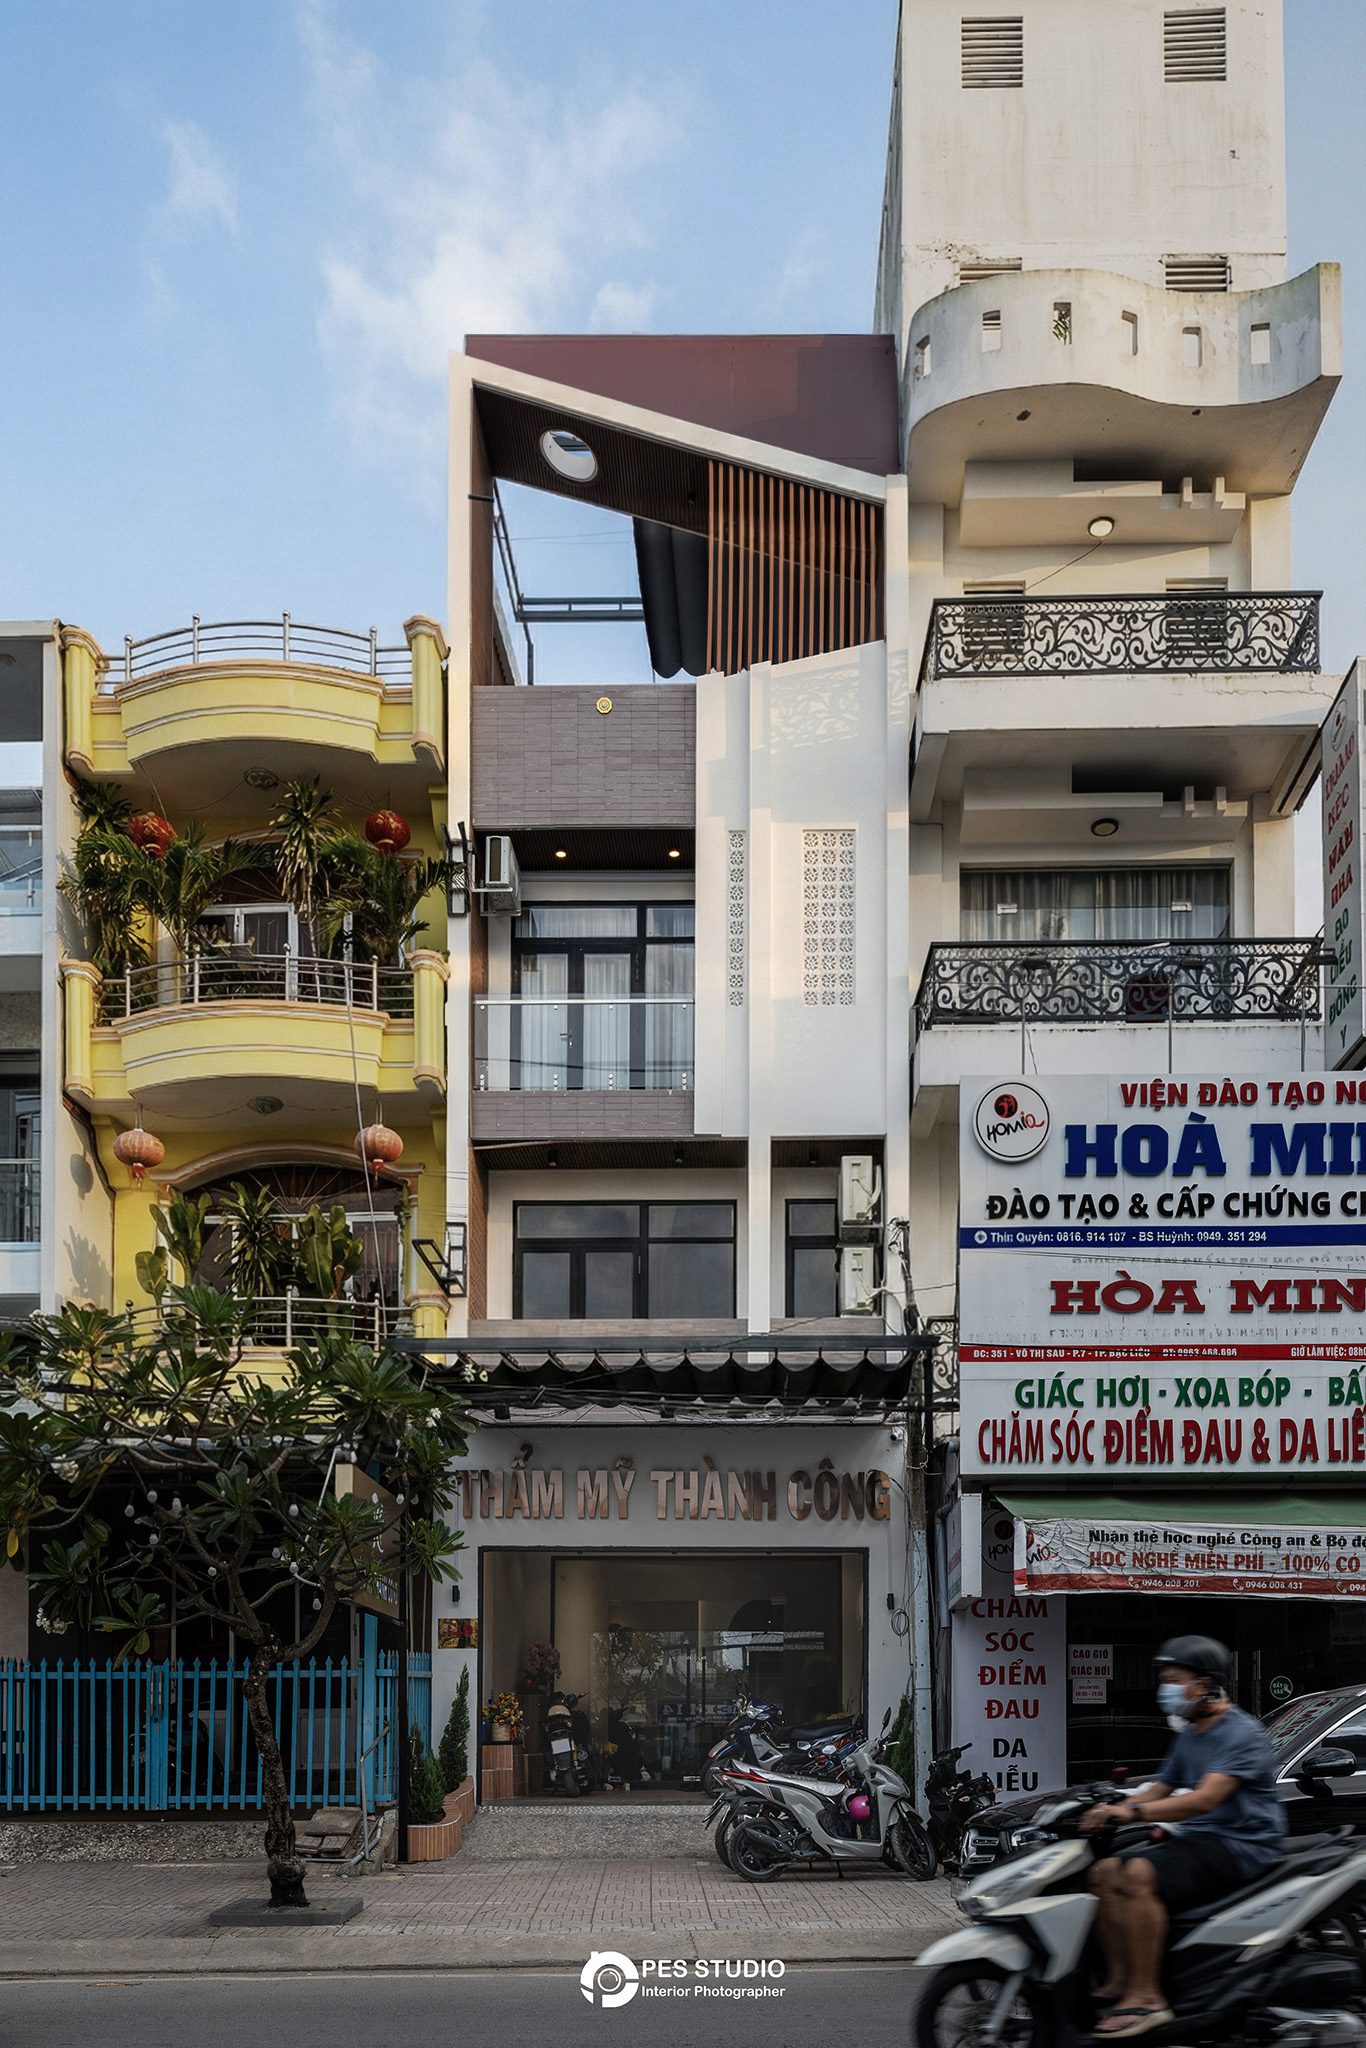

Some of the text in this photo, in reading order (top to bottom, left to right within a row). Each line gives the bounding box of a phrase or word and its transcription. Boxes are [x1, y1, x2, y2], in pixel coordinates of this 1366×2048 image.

[1120, 1081, 1188, 1111] VIỆN
[1199, 1078, 1258, 1106] ĐÀO
[1267, 1081, 1325, 1109] TẠO
[1065, 1111, 1366, 1177] HOÀ MI
[986, 1187, 1050, 1219] ĐÀO
[1058, 1193, 1119, 1224] TẠO
[1129, 1193, 1149, 1218] &
[1157, 1184, 1215, 1218] CẤP
[1223, 1184, 1330, 1217] CHỨNG
[1087, 1231, 1105, 1242] 914
[1108, 1231, 1126, 1242] 107
[1139, 1231, 1154, 1242] BS
[1227, 1231, 1245, 1242] 351
[1248, 1231, 1267, 1242] 294
[1050, 1270, 1206, 1314] HÒA
[991, 1349, 1007, 1358] 351
[1030, 1349, 1044, 1360] THỊ
[1306, 1345, 1324, 1357] LÀM
[1015, 1372, 1084, 1408] GIÁC
[1096, 1374, 1150, 1408] HƠI
[1175, 1378, 1229, 1408] XOA
[1239, 1369, 1291, 1407] BÓP
[1328, 1365, 1366, 1406] BẤ
[978, 1411, 1044, 1463] CHĂM
[1051, 1410, 1095, 1463] SÓC
[1104, 1404, 1174, 1463] ĐIỂM
[1182, 1418, 1242, 1463] ĐAU
[1251, 1418, 1271, 1462] &
[1279, 1418, 1319, 1462] DA
[458, 1443, 891, 1522] THẨM MỸ THÀNH CÔNG
[1089, 1530, 1128, 1544] Nhận
[1164, 1531, 1192, 1546] học
[1240, 1533, 1281, 1548] Công
[1286, 1536, 1305, 1546] an
[1310, 1534, 1321, 1546] &
[1327, 1534, 1347, 1549] Bộ
[1090, 1551, 1126, 1569] HỌC
[1234, 1551, 1264, 1570] PHÍ
[1281, 1554, 1330, 1571] 100%
[1336, 1552, 1360, 1573] CÓ
[1245, 1581, 1267, 1589] 0946
[985, 1627, 1034, 1652] SÓC
[978, 1658, 1047, 1686] ĐIỂM
[985, 1699, 1039, 1720] ĐAU
[992, 1738, 1028, 1758] DA
[982, 1764, 1038, 1791] IỄU
